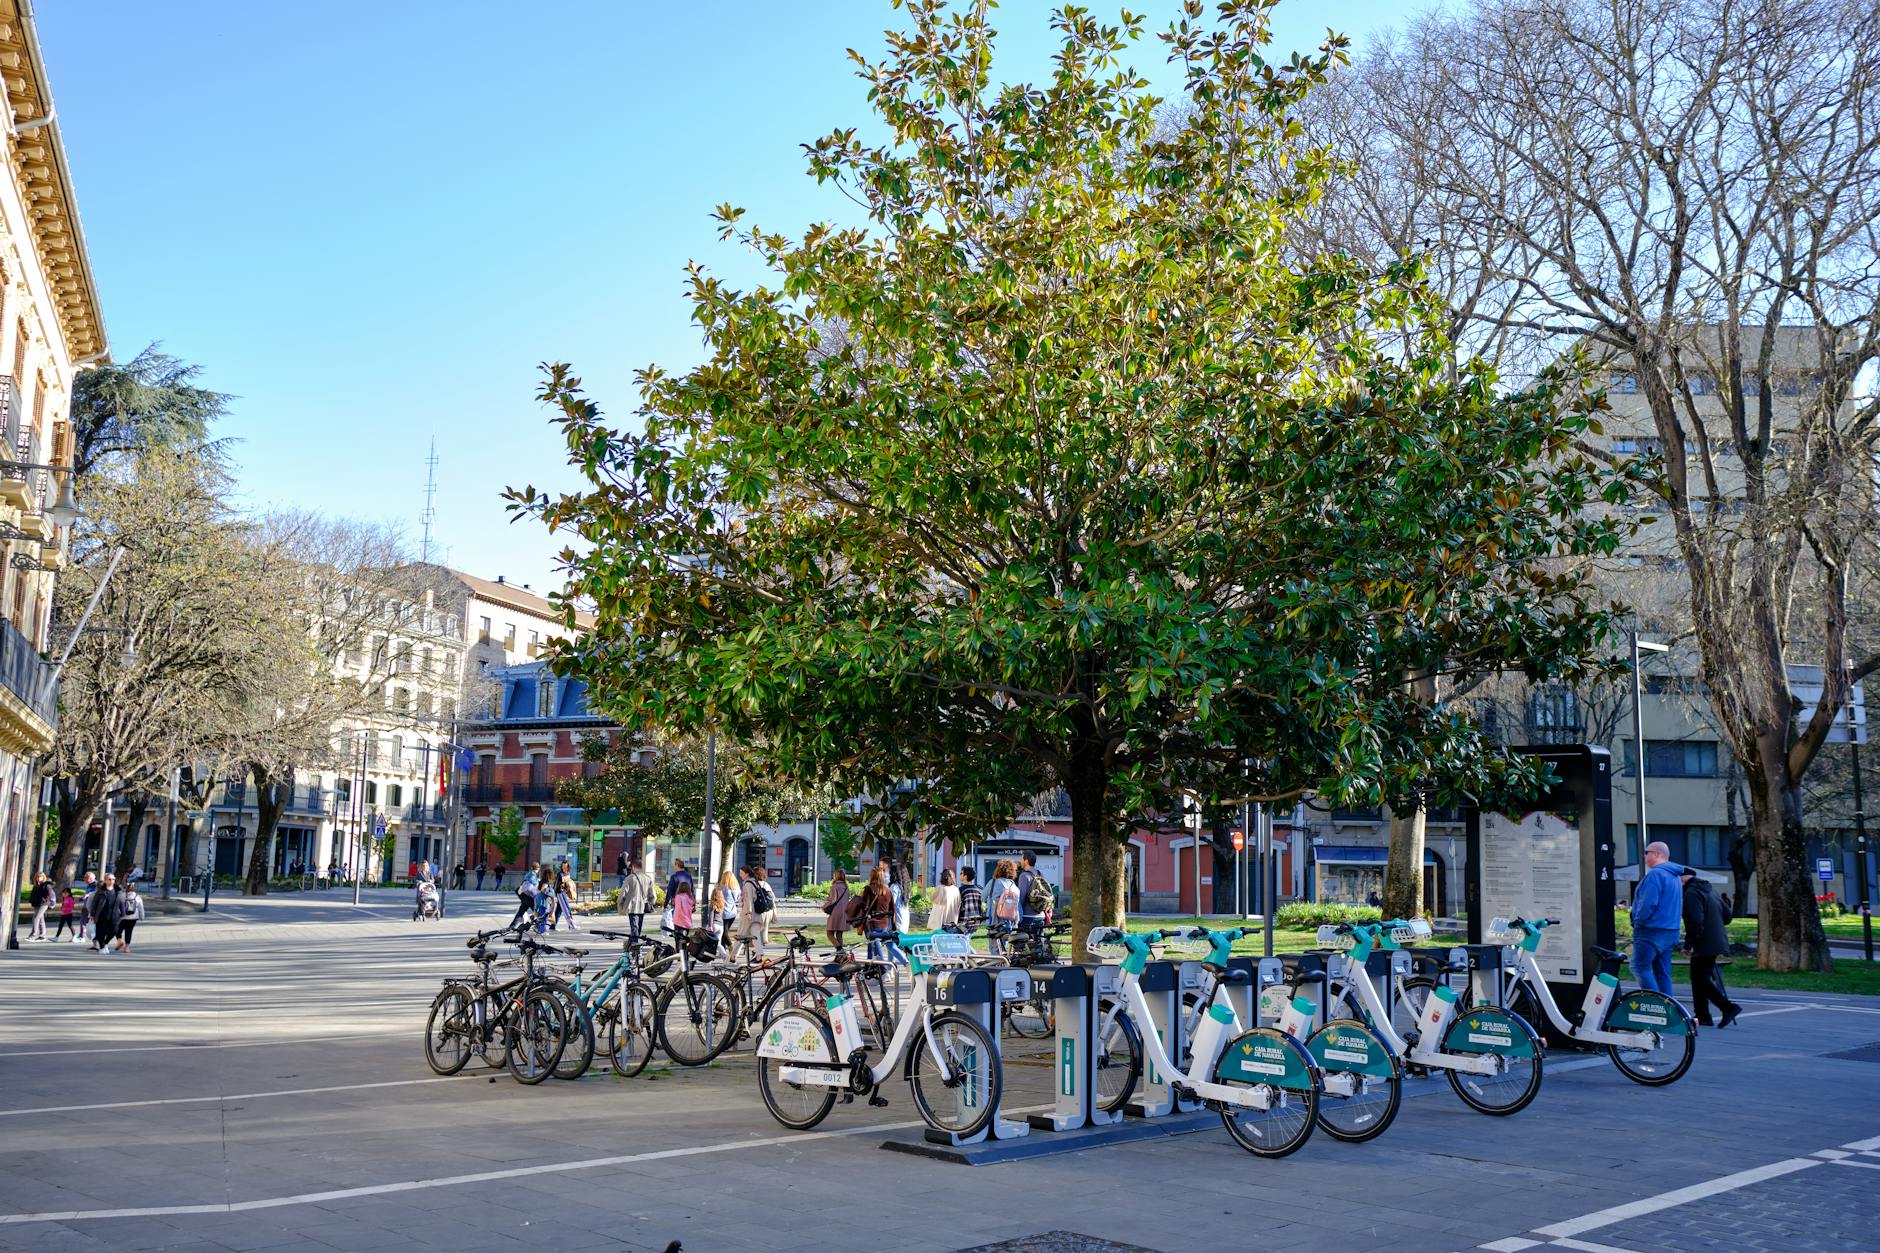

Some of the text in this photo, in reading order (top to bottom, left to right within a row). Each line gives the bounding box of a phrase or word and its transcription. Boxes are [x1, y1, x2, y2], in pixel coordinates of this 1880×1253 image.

[1412, 962, 1419, 970] 4
[1470, 958, 1476, 968] 2
[1033, 981, 1047, 994] 14
[934, 987, 947, 1000] 16
[823, 1073, 841, 1082] 0012
